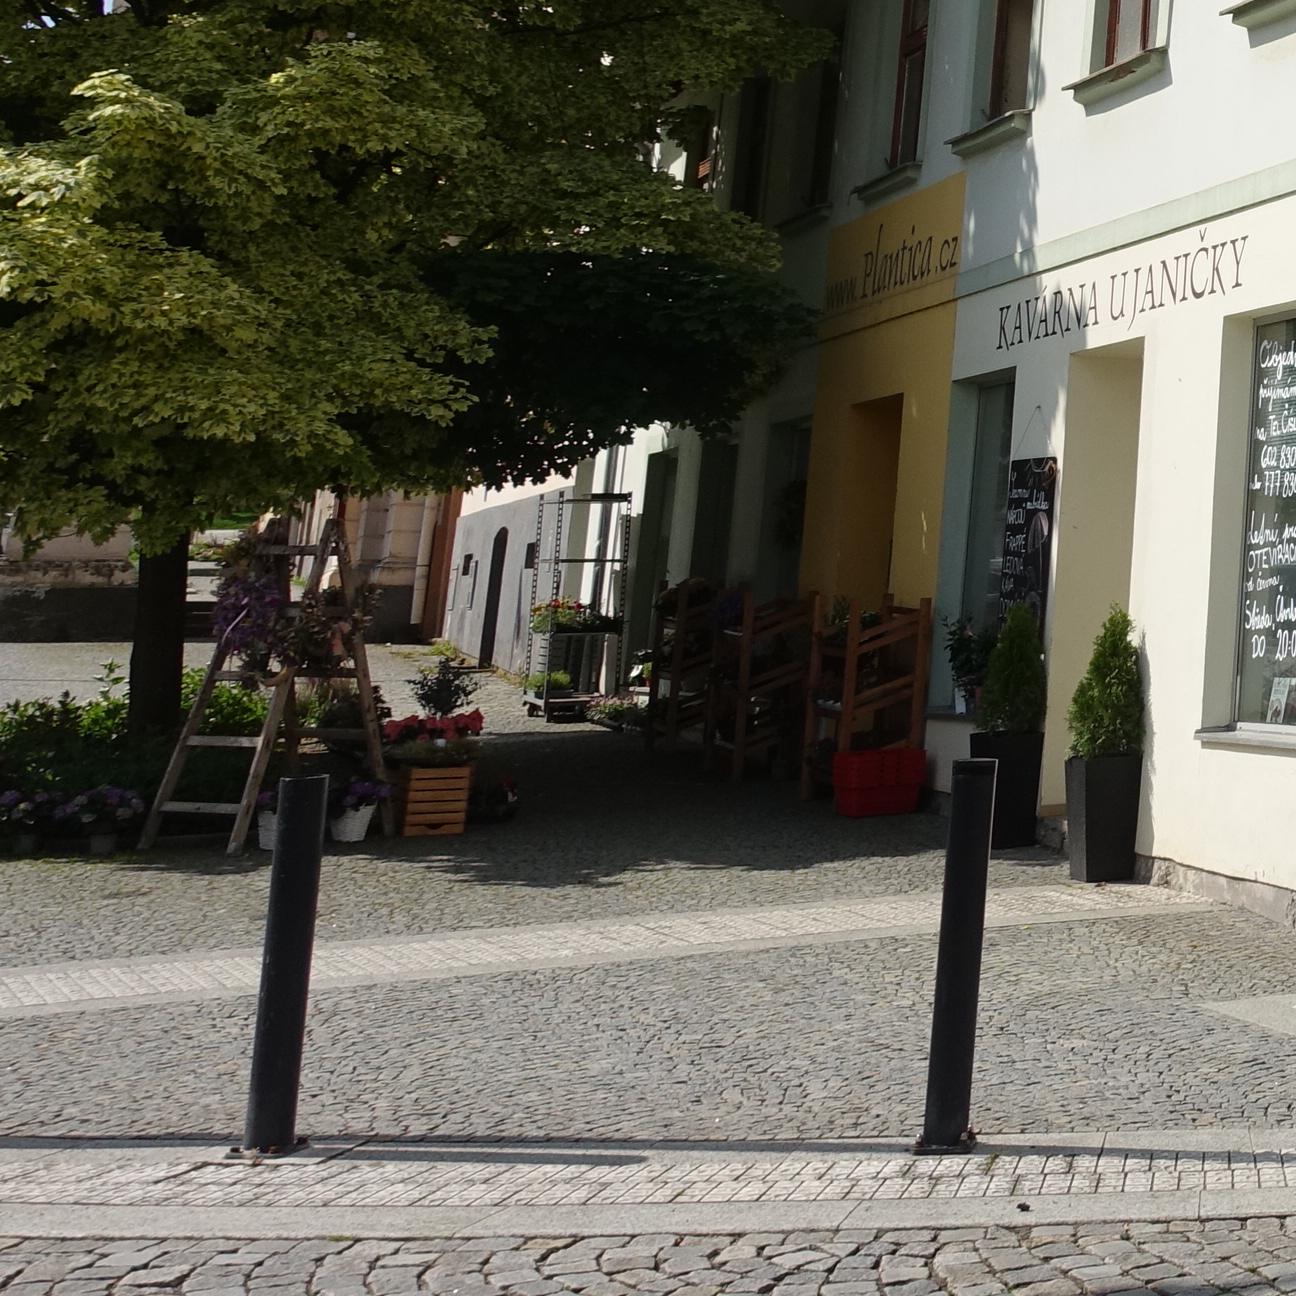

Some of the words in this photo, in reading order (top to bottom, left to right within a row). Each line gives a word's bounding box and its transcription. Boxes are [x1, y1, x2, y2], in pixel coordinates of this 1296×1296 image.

[996, 283, 1100, 351] KAVÁRNA
[1261, 444, 1277, 468] 602
[1280, 444, 1296, 469] 830
[1264, 470, 1281, 497] 777
